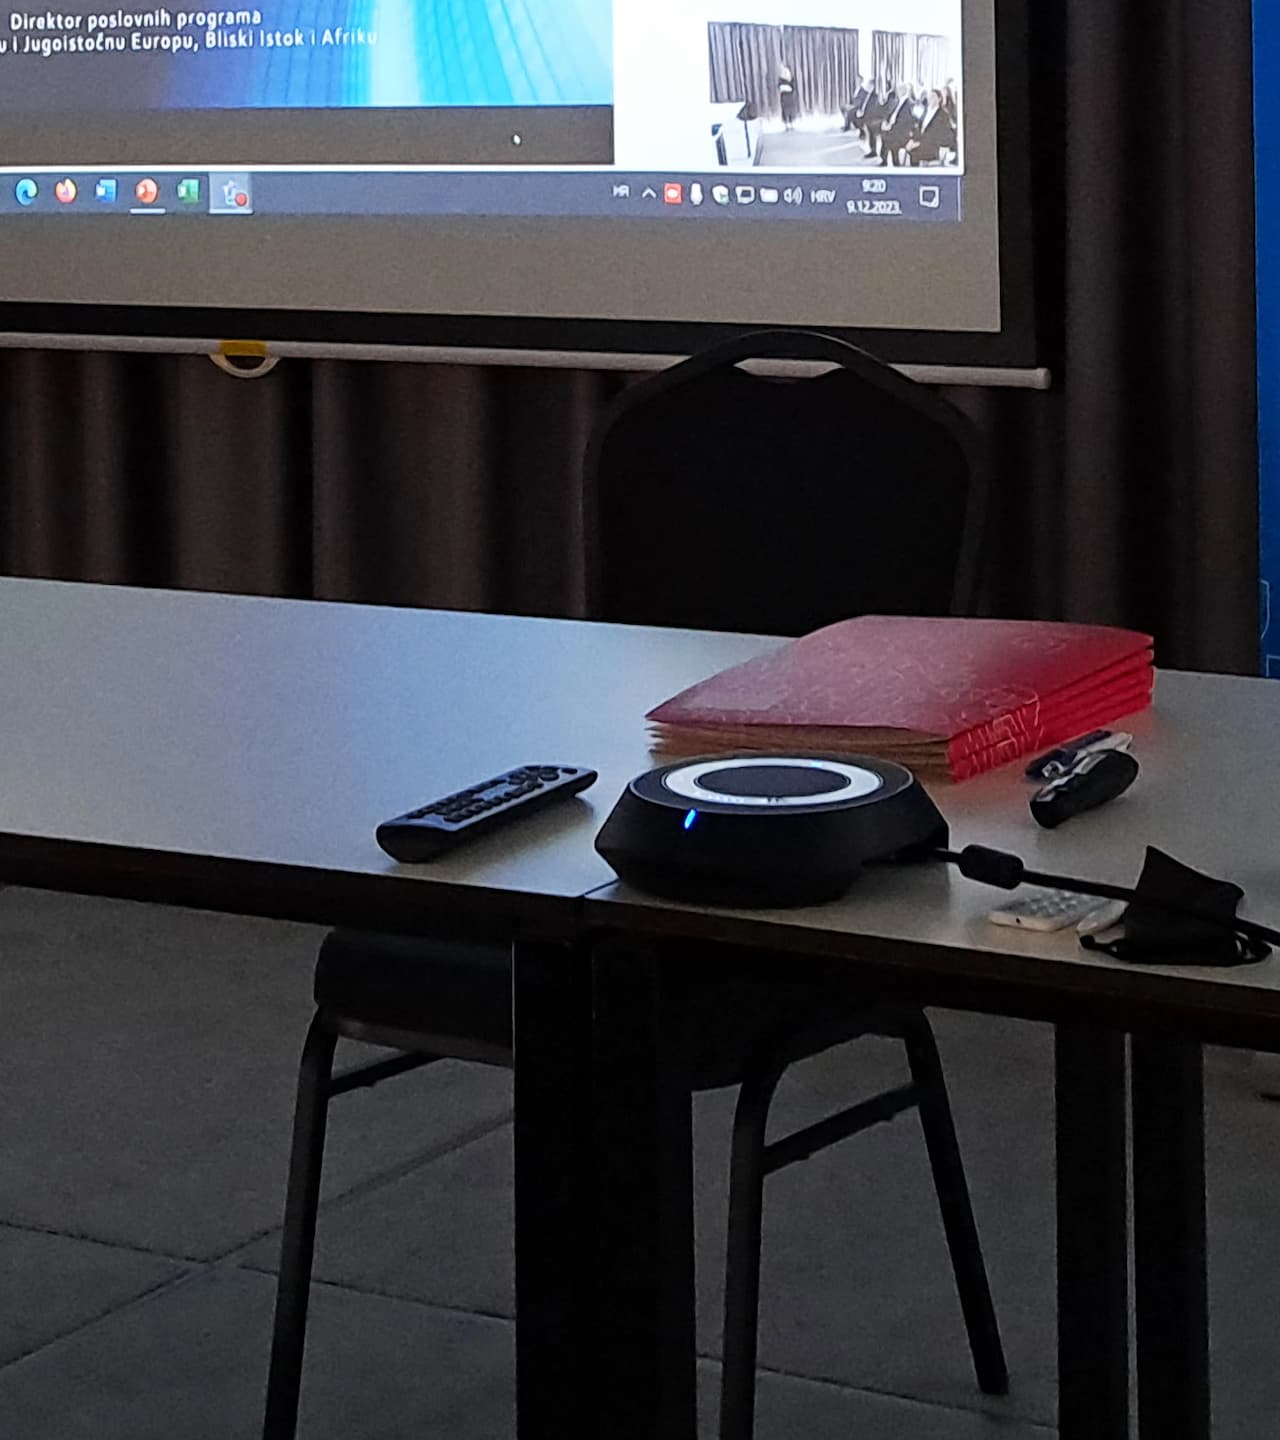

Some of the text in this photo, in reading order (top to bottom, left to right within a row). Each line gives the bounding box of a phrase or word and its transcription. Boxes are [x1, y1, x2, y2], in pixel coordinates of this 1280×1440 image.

[10, 8, 262, 38] Direktor poslovnih programa
[23, 32, 125, 59] Jugoistočnu
[130, 31, 200, 54] Europu,
[205, 28, 255, 49] Bliski
[259, 27, 305, 49] Istok
[321, 26, 378, 47] Afriku
[811, 190, 836, 203] HRV
